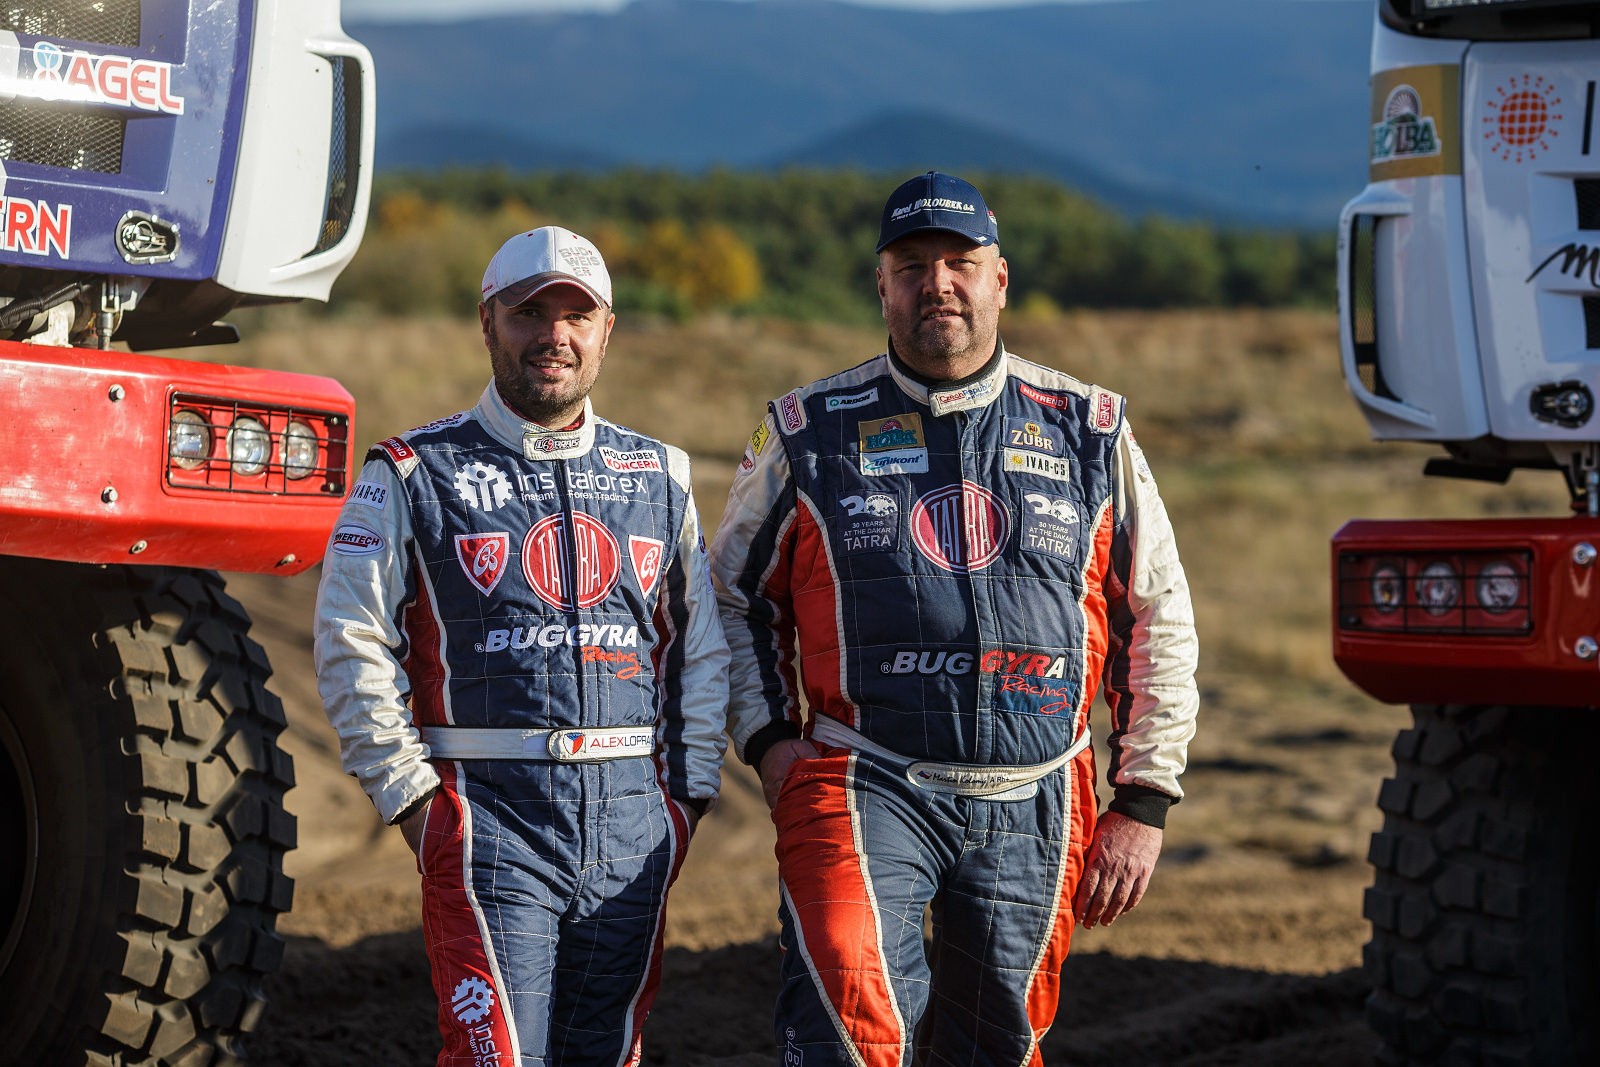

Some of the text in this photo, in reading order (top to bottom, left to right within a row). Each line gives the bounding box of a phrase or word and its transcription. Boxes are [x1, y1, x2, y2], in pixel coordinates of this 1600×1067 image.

[68, 57, 182, 110] AGEL
[914, 197, 963, 210] HOLOUBEK
[0, 200, 69, 256] RN
[1022, 388, 1065, 407] NUTREND
[1011, 430, 1054, 451] ZUBR
[602, 449, 654, 462] HOLOUBEK
[606, 459, 660, 470] KONCERN
[1026, 455, 1067, 476] IVAR-CS
[521, 490, 629, 504] Instant Forex Trading
[861, 520, 884, 528] YEARS
[931, 489, 991, 564] TATRA
[1048, 523, 1069, 534] YEARS
[843, 534, 891, 551] TATRA
[1029, 526, 1073, 544] AT THE DAKAR
[1028, 533, 1071, 558] TATRA
[538, 524, 601, 599] TATRA
[580, 645, 642, 681] Racing
[1000, 675, 1071, 715] Racing
